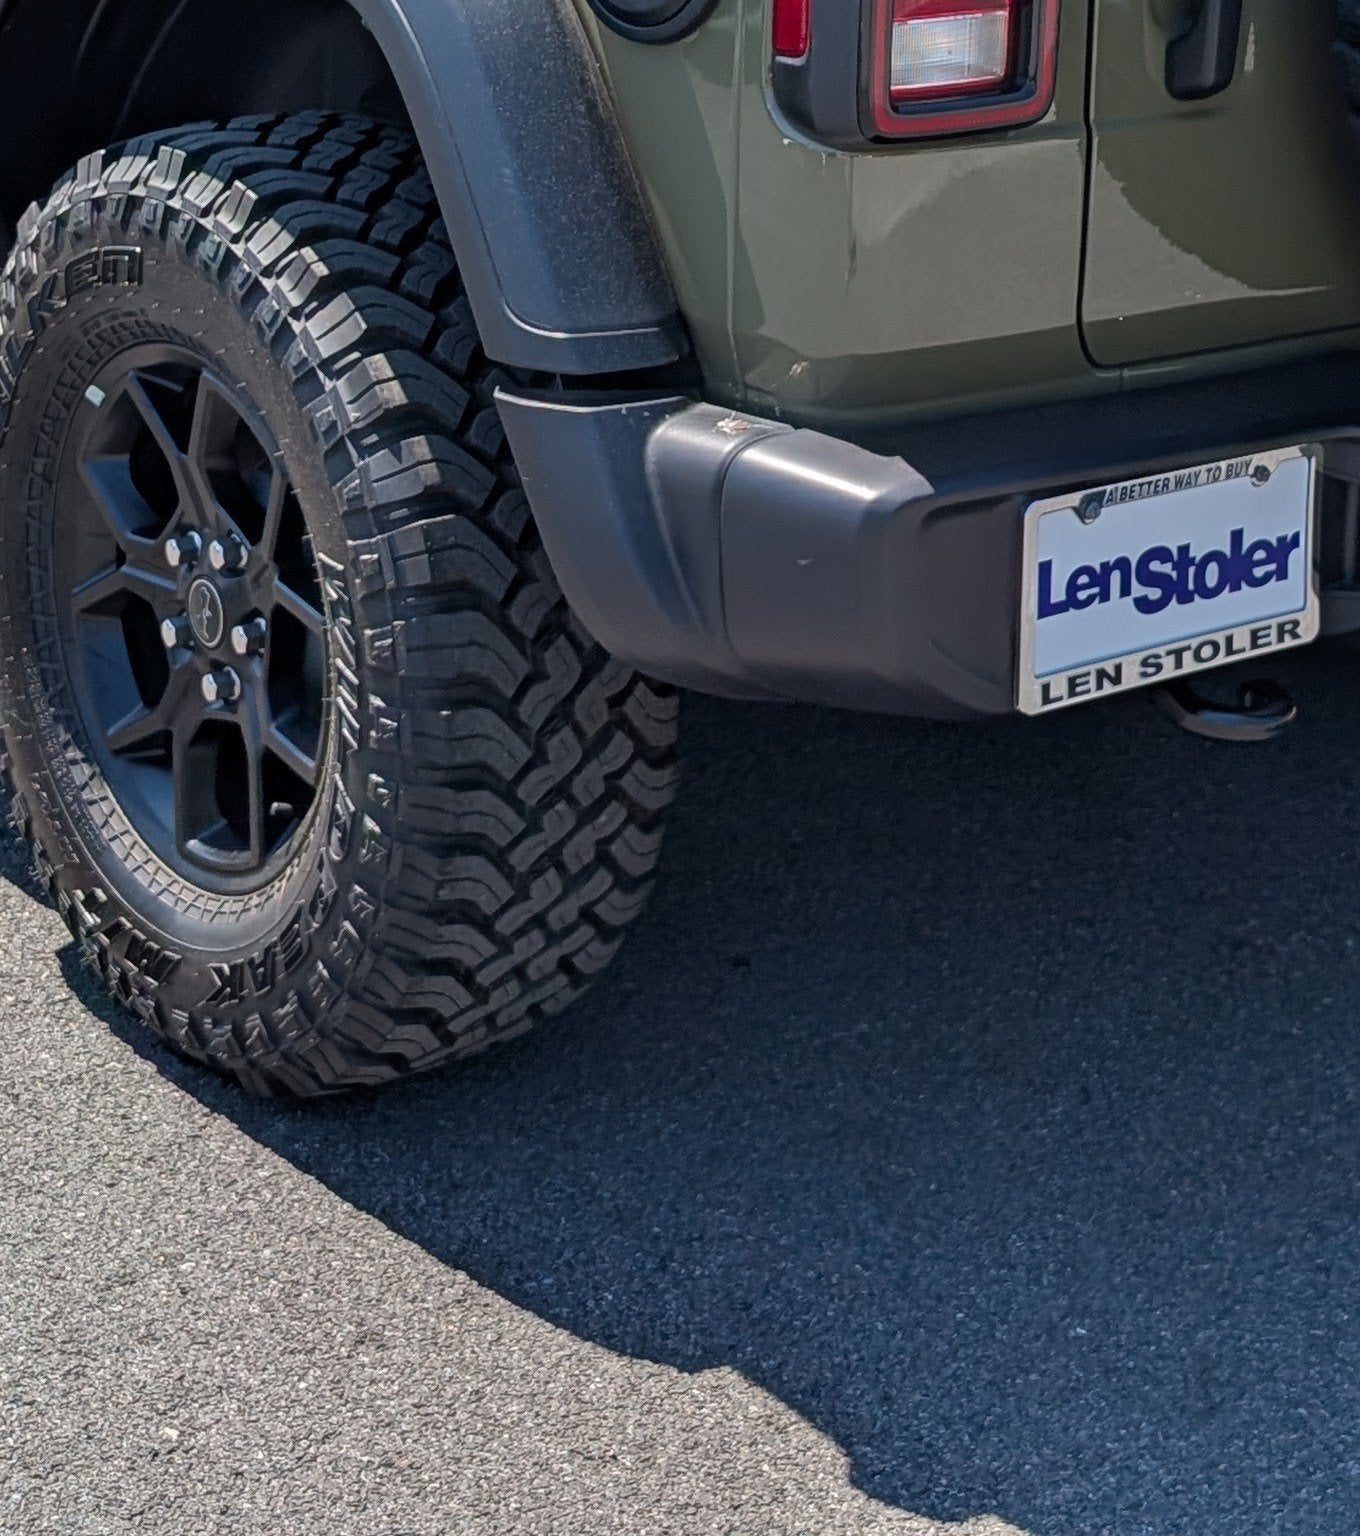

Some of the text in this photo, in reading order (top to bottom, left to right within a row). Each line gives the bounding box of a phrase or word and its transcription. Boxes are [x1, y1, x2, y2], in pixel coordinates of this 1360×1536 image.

[1119, 477, 1171, 502] BETTER
[1174, 471, 1203, 490] WAY
[1206, 466, 1223, 483] TO
[1225, 458, 1253, 479] BUY
[1041, 618, 1302, 706] LEN STOLER
